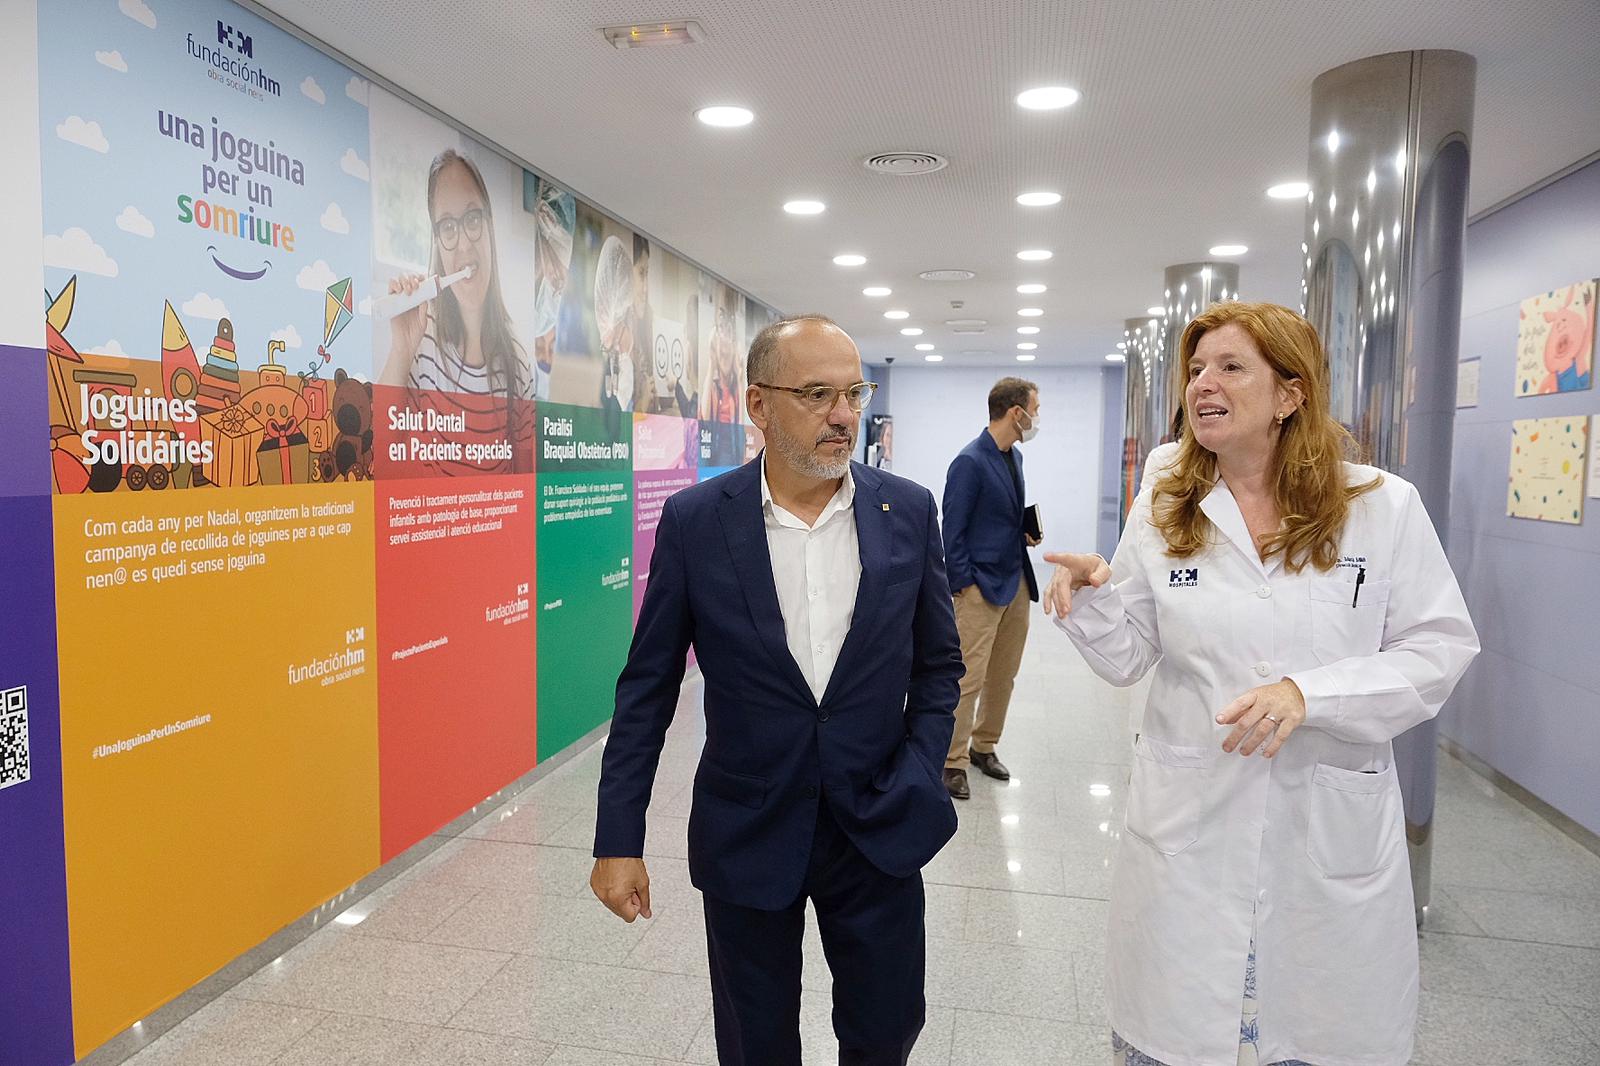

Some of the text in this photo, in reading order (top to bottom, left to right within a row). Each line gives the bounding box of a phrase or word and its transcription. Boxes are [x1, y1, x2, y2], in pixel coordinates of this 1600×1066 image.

[187, 33, 281, 97] fundaciónhm
[226, 78, 247, 94] social
[158, 110, 305, 186] una joguina
[202, 164, 273, 208] per un
[177, 194, 295, 252] somriure
[80, 383, 198, 429] Joguines
[388, 405, 466, 433] Salut Dental
[81, 429, 214, 466] Solidáries
[388, 437, 513, 465] en Pacients especials
[543, 440, 577, 463] Braquial
[84, 500, 355, 537] Com cada any per Nadal, organitzem la tradicional
[85, 522, 352, 564] campanya de recollida de joguines per a que cap
[86, 550, 266, 589] nen@ es quedi sense joguina
[287, 647, 365, 685] fundaciónhm
